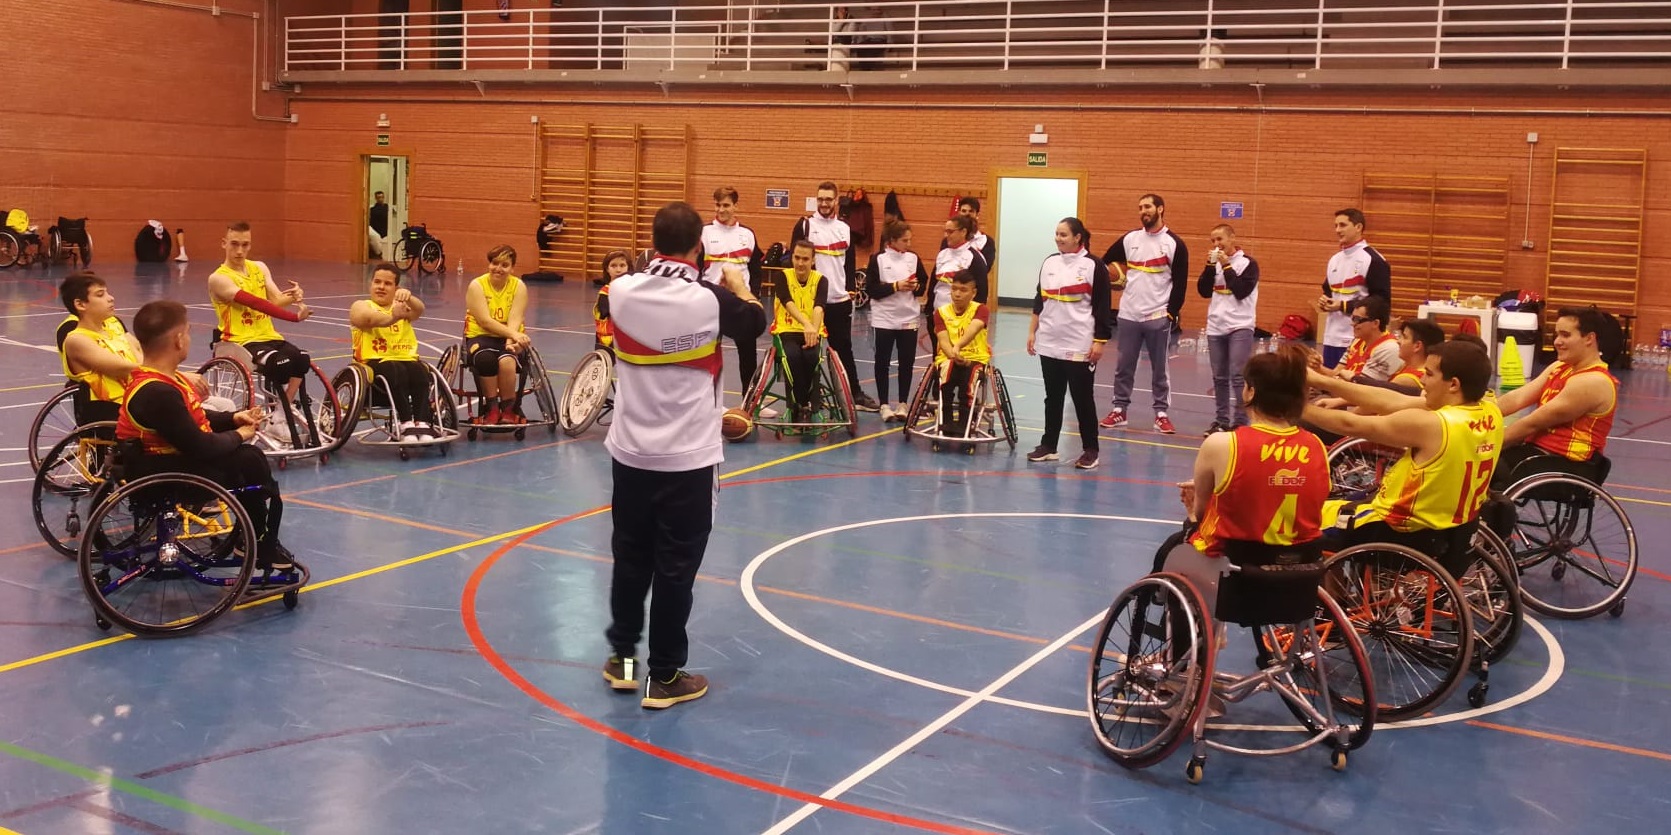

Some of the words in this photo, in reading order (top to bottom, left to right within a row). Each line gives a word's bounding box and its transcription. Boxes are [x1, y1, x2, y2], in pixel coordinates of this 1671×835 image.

[1029, 155, 1046, 163] SALIDA
[1451, 457, 1494, 525] 12
[1262, 493, 1298, 546] 4
